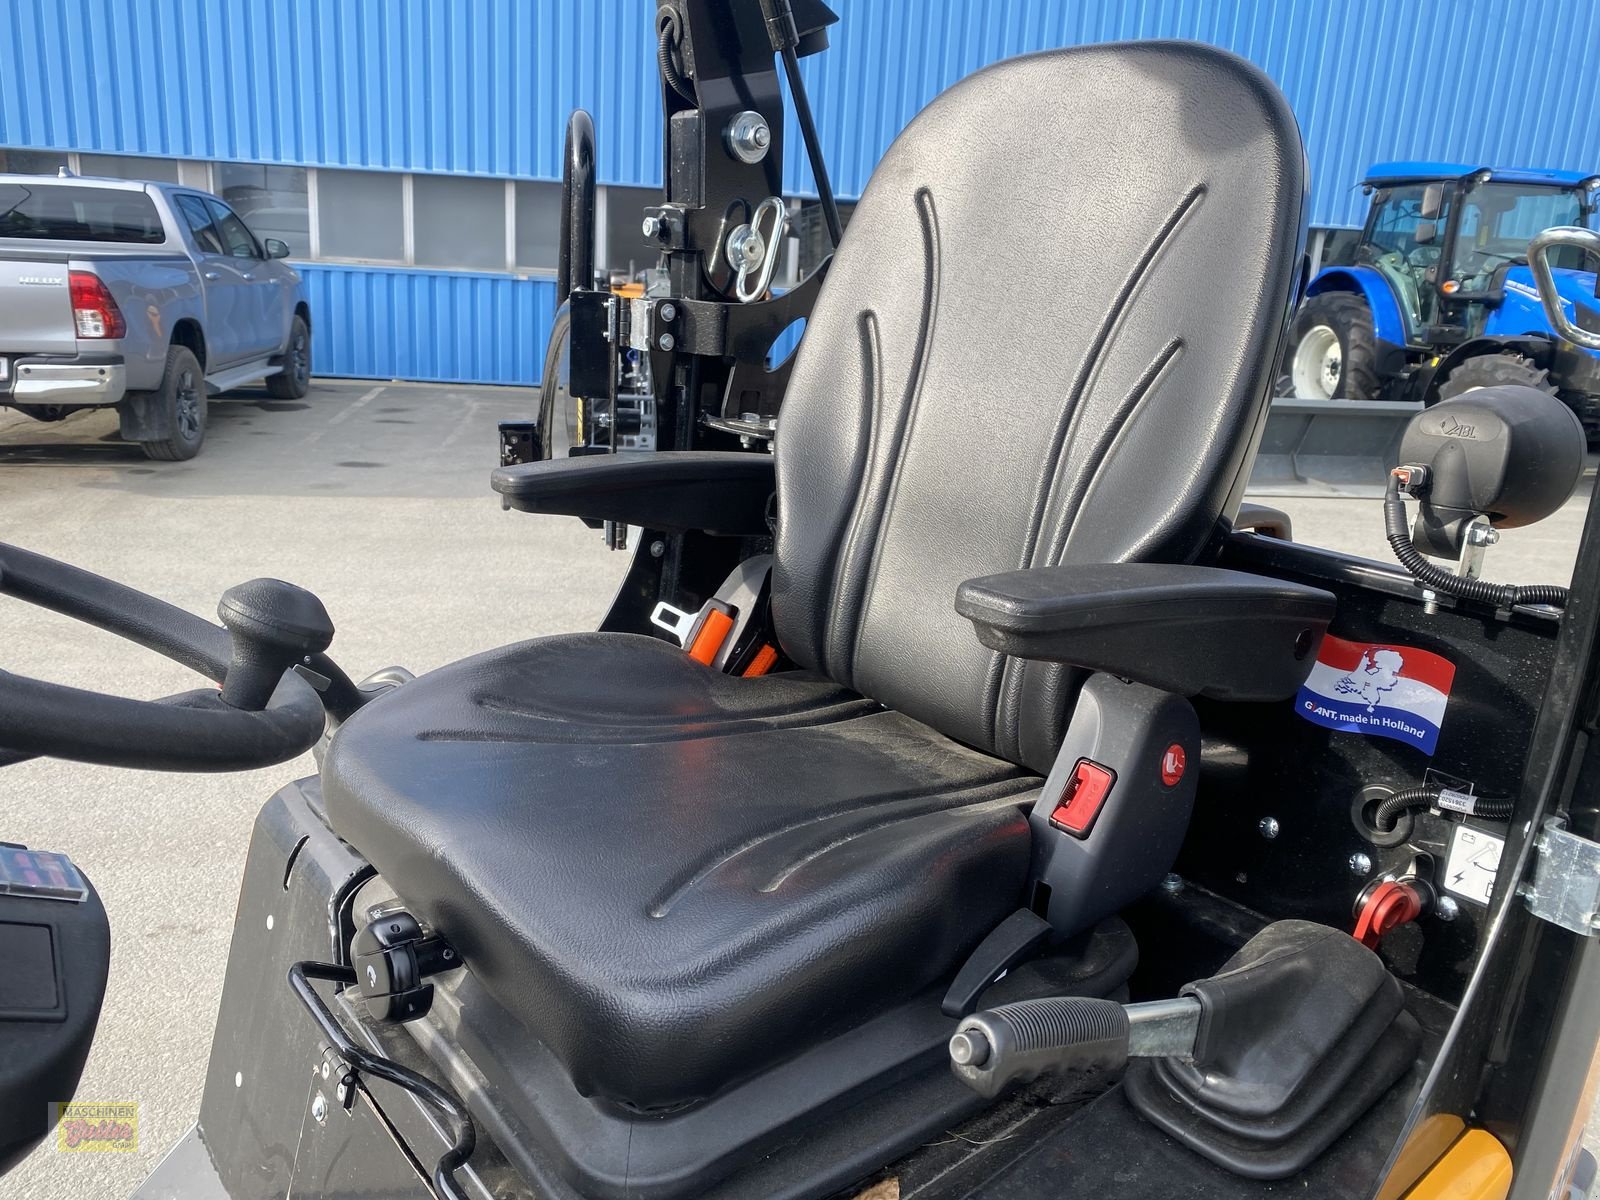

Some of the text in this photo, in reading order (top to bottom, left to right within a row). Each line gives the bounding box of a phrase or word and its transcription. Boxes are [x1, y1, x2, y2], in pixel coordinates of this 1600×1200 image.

[19, 276, 62, 286] HILUX
[1340, 713, 1368, 725] made
[1370, 715, 1380, 726] in
[1382, 717, 1426, 740] Holland
